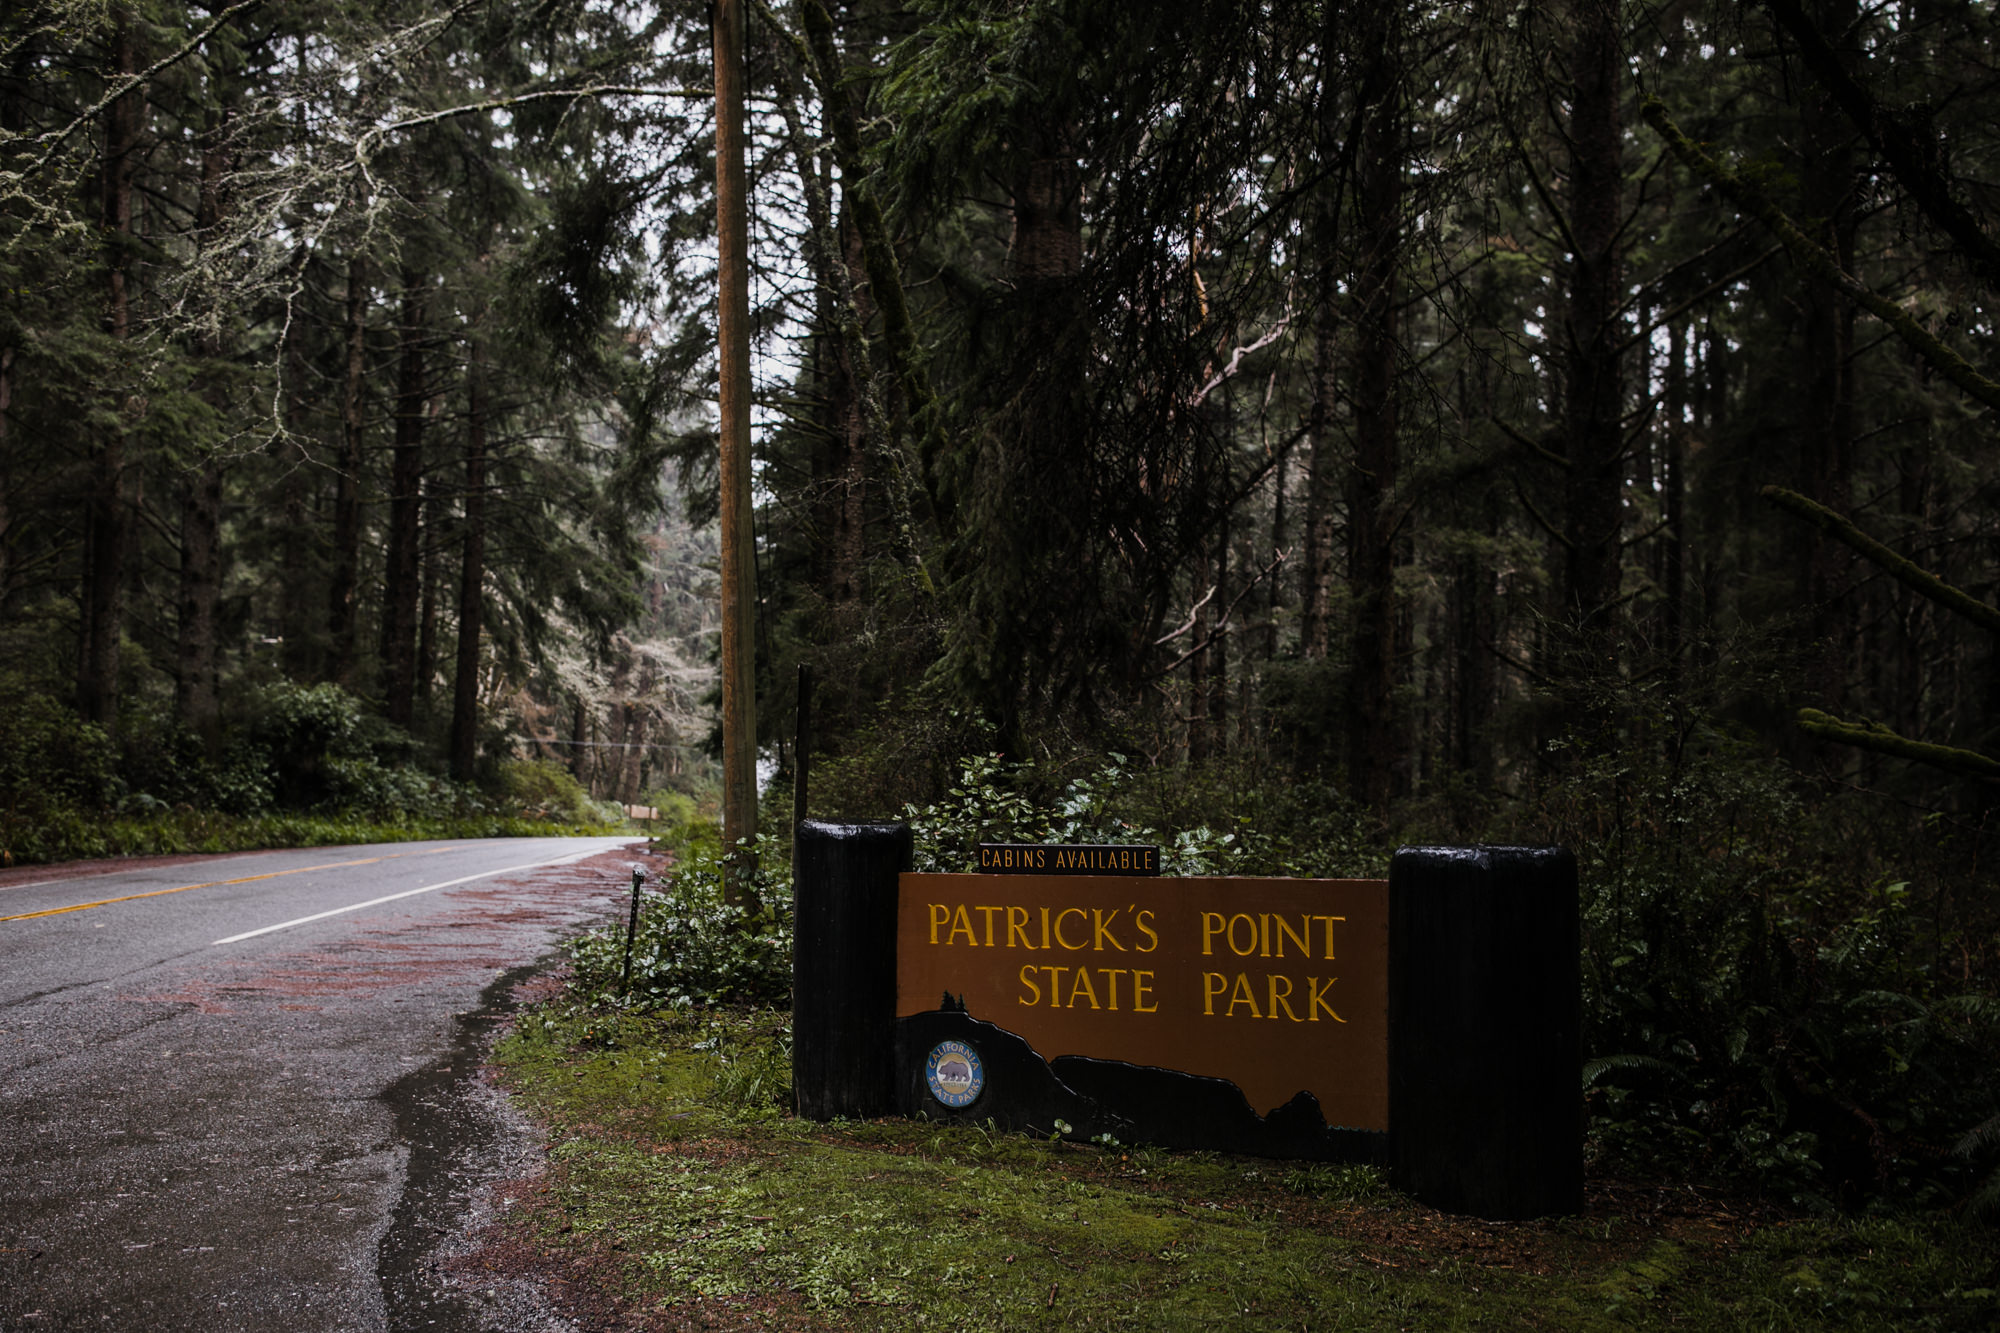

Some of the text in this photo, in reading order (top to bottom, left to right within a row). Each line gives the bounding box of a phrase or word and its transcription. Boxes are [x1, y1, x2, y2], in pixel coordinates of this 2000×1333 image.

[982, 848, 1152, 870] CABINS AVAILABLE
[928, 903, 1346, 960] PATRICK'S POINT
[1018, 965, 1347, 1023] STATE PARK
[929, 1043, 979, 1071] CALIFORNIA
[929, 1076, 981, 1104] STATE PARKS
